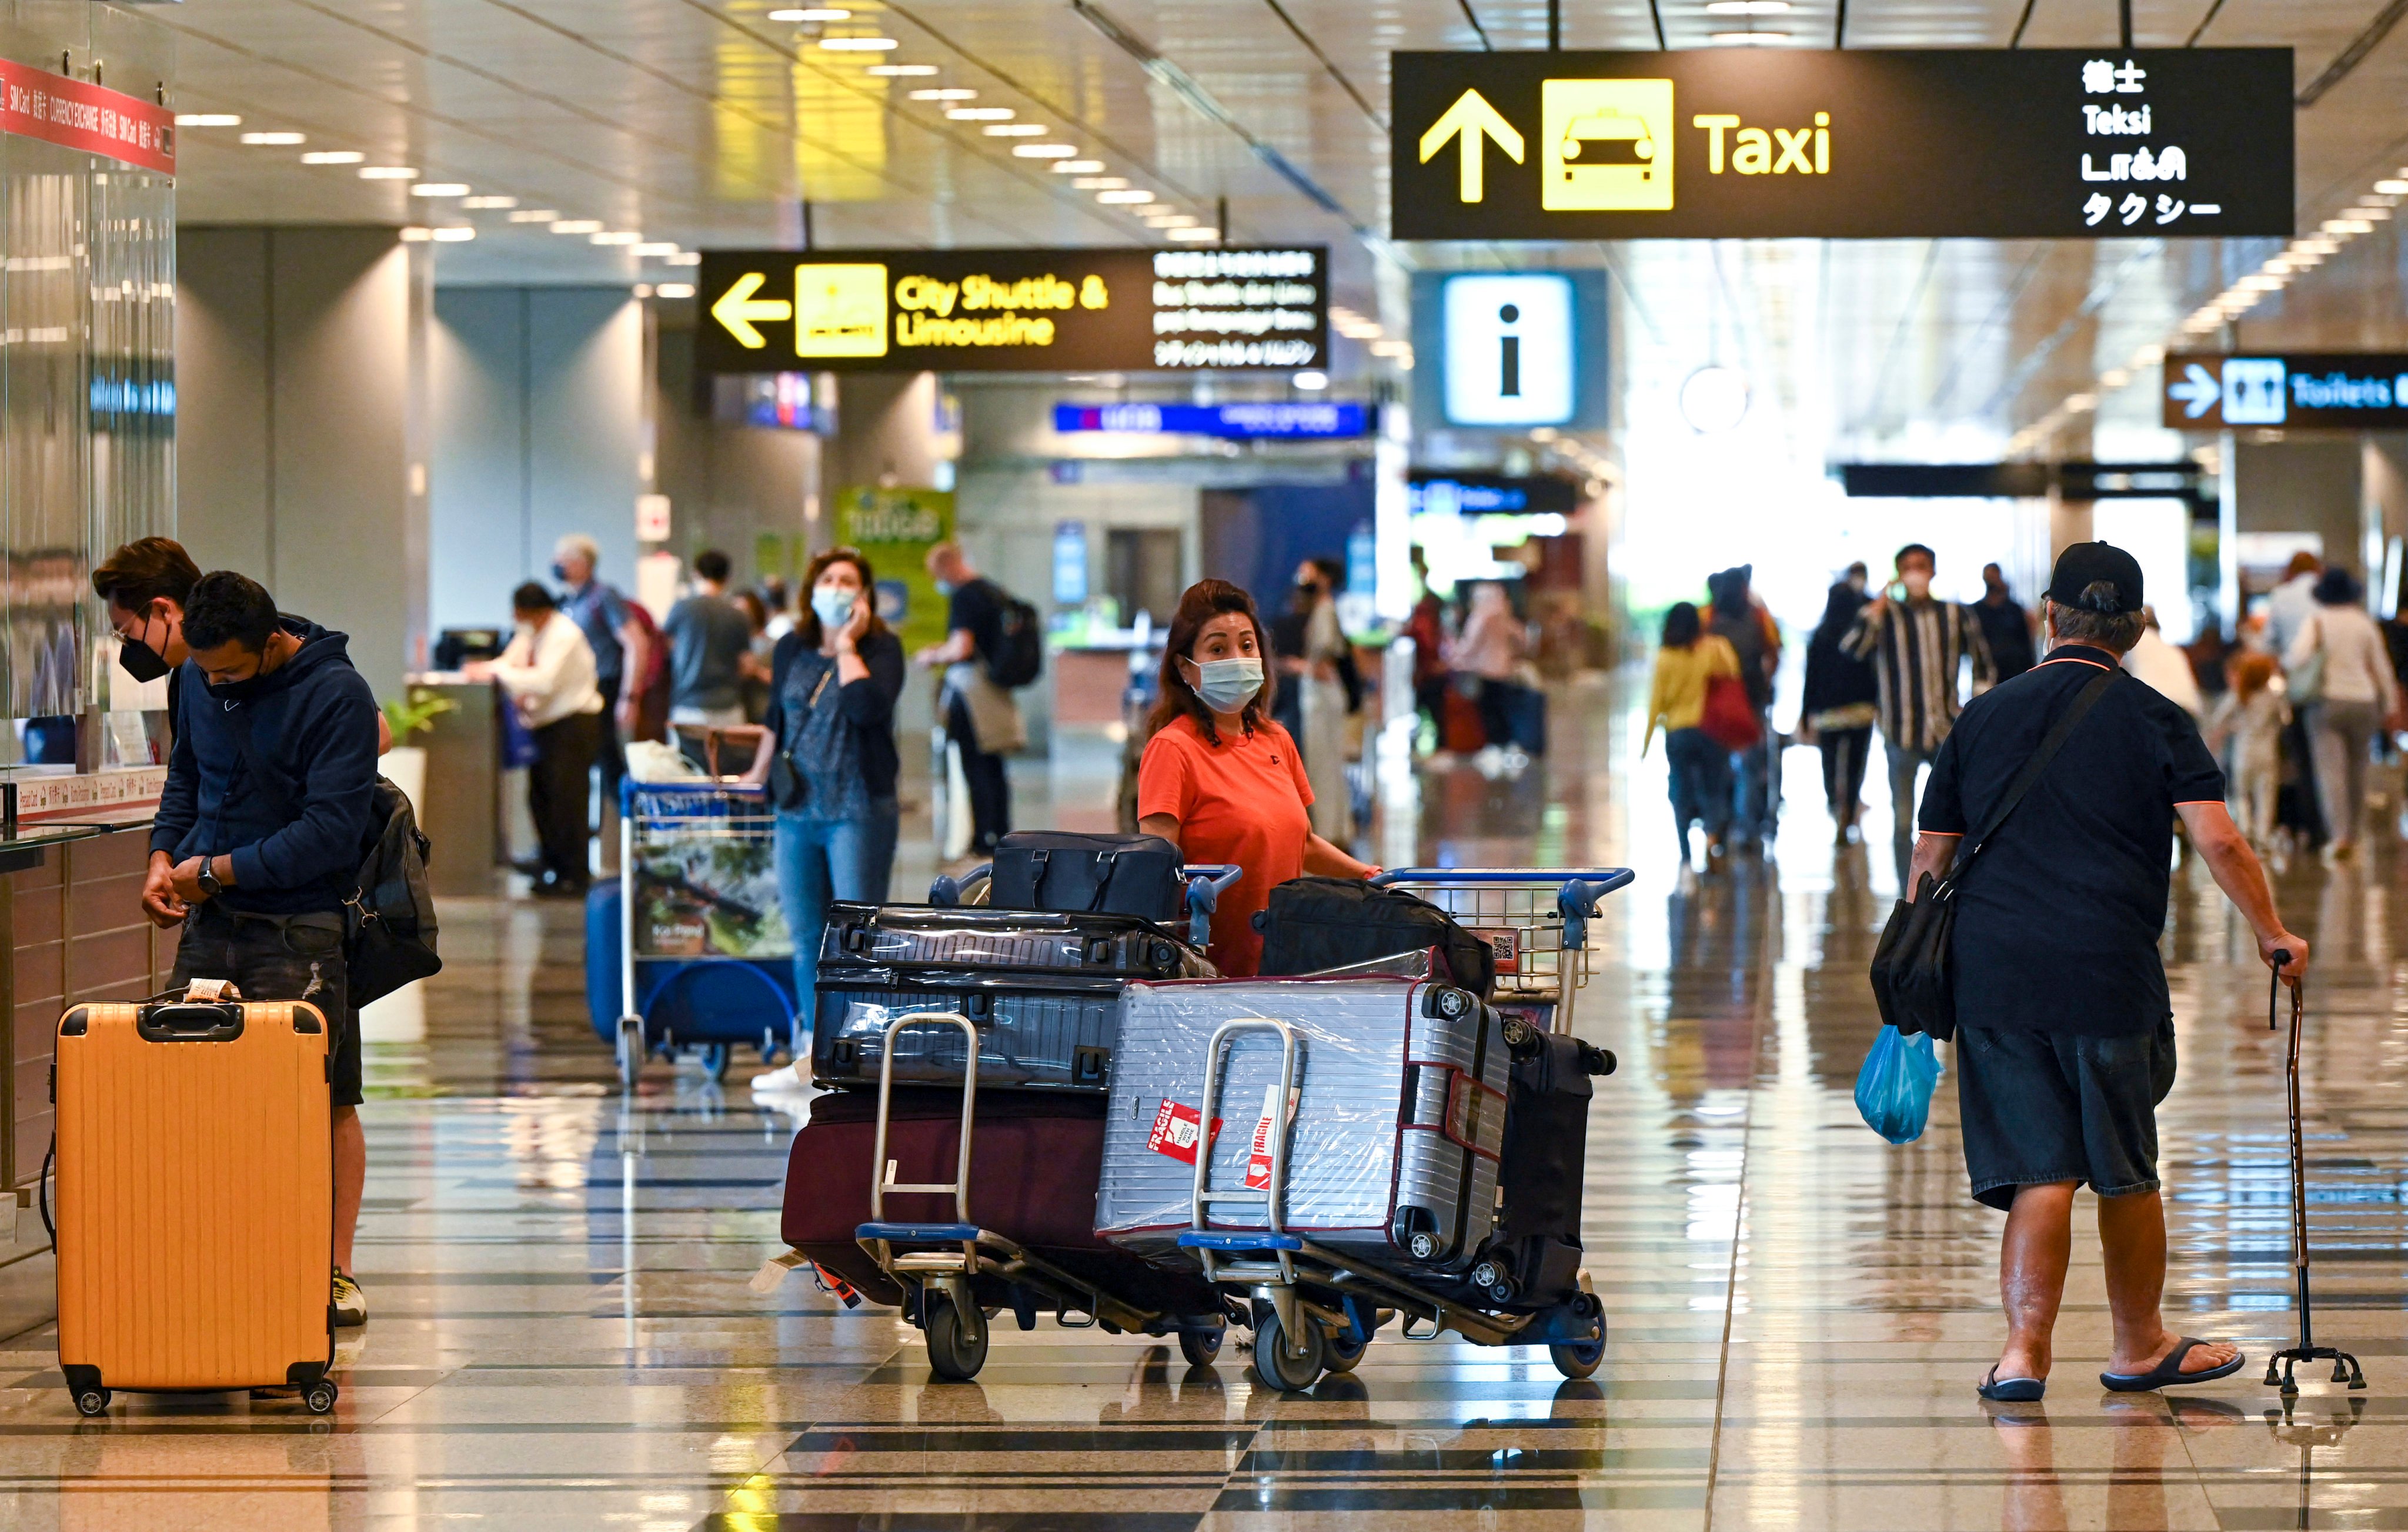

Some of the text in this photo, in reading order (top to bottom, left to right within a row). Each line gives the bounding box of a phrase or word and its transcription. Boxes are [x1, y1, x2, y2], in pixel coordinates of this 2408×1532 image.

[19, 86, 29, 115] Card
[51, 96, 98, 132] CURRENCY EXCHANGE
[2082, 103, 2151, 135] Teksi
[1693, 112, 1830, 175] Taxi
[2082, 192, 2221, 226] タクシー
[895, 273, 1108, 317] City Shuttle &
[896, 310, 1055, 346] Limousine
[2289, 372, 2392, 408] Toilets
[1148, 1099, 1175, 1151] FRAGILE
[1176, 1123, 1188, 1144] HANDLE
[1181, 1128, 1190, 1142] WITH
[1185, 1129, 1194, 1143] CARE
[1254, 1116, 1272, 1153] FRAGILE
